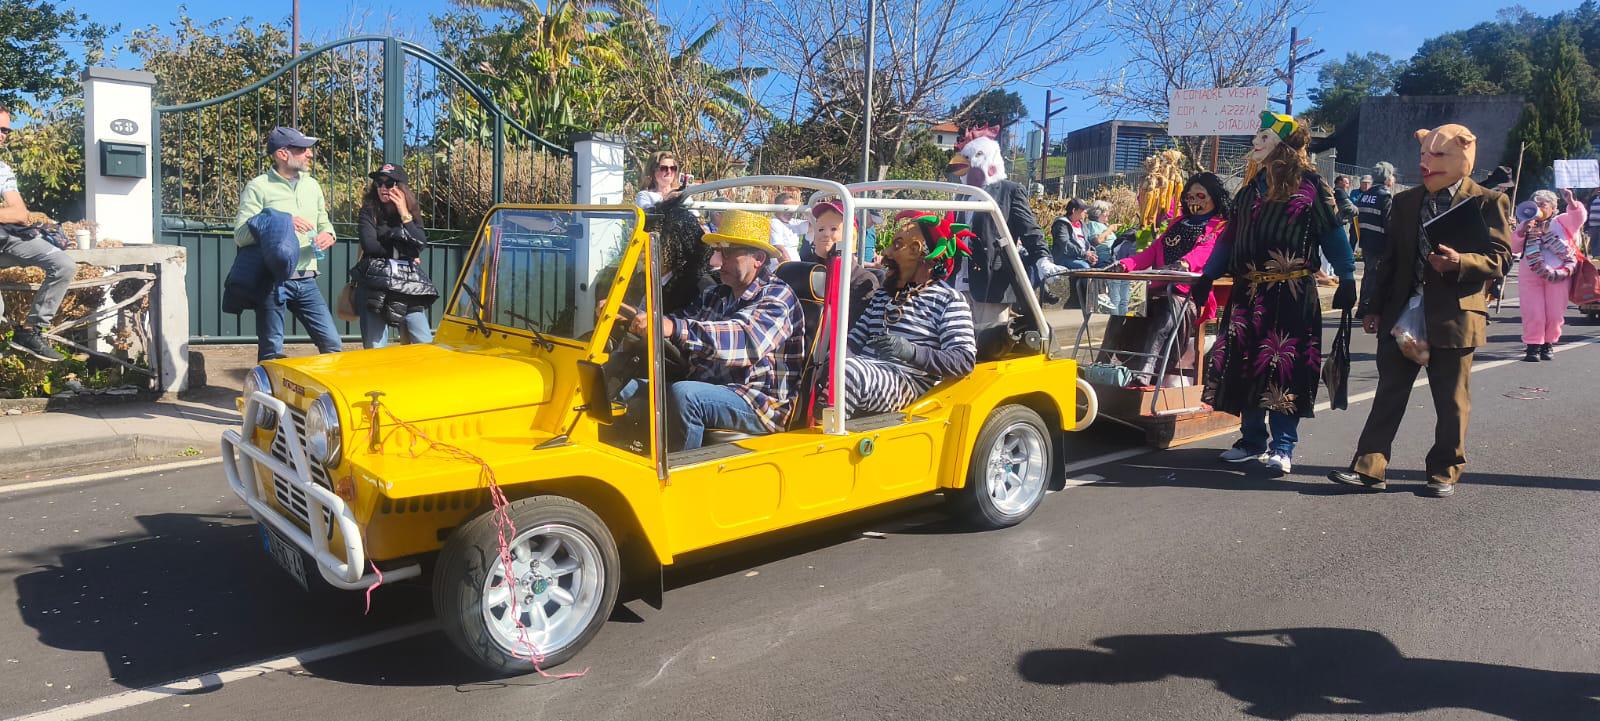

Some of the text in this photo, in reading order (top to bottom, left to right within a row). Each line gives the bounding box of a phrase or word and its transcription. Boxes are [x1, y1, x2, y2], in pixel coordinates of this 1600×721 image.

[1228, 88, 1259, 99] VESPA
[1177, 106, 1195, 116] COM
[1185, 119, 1262, 130] DA DITADURA
